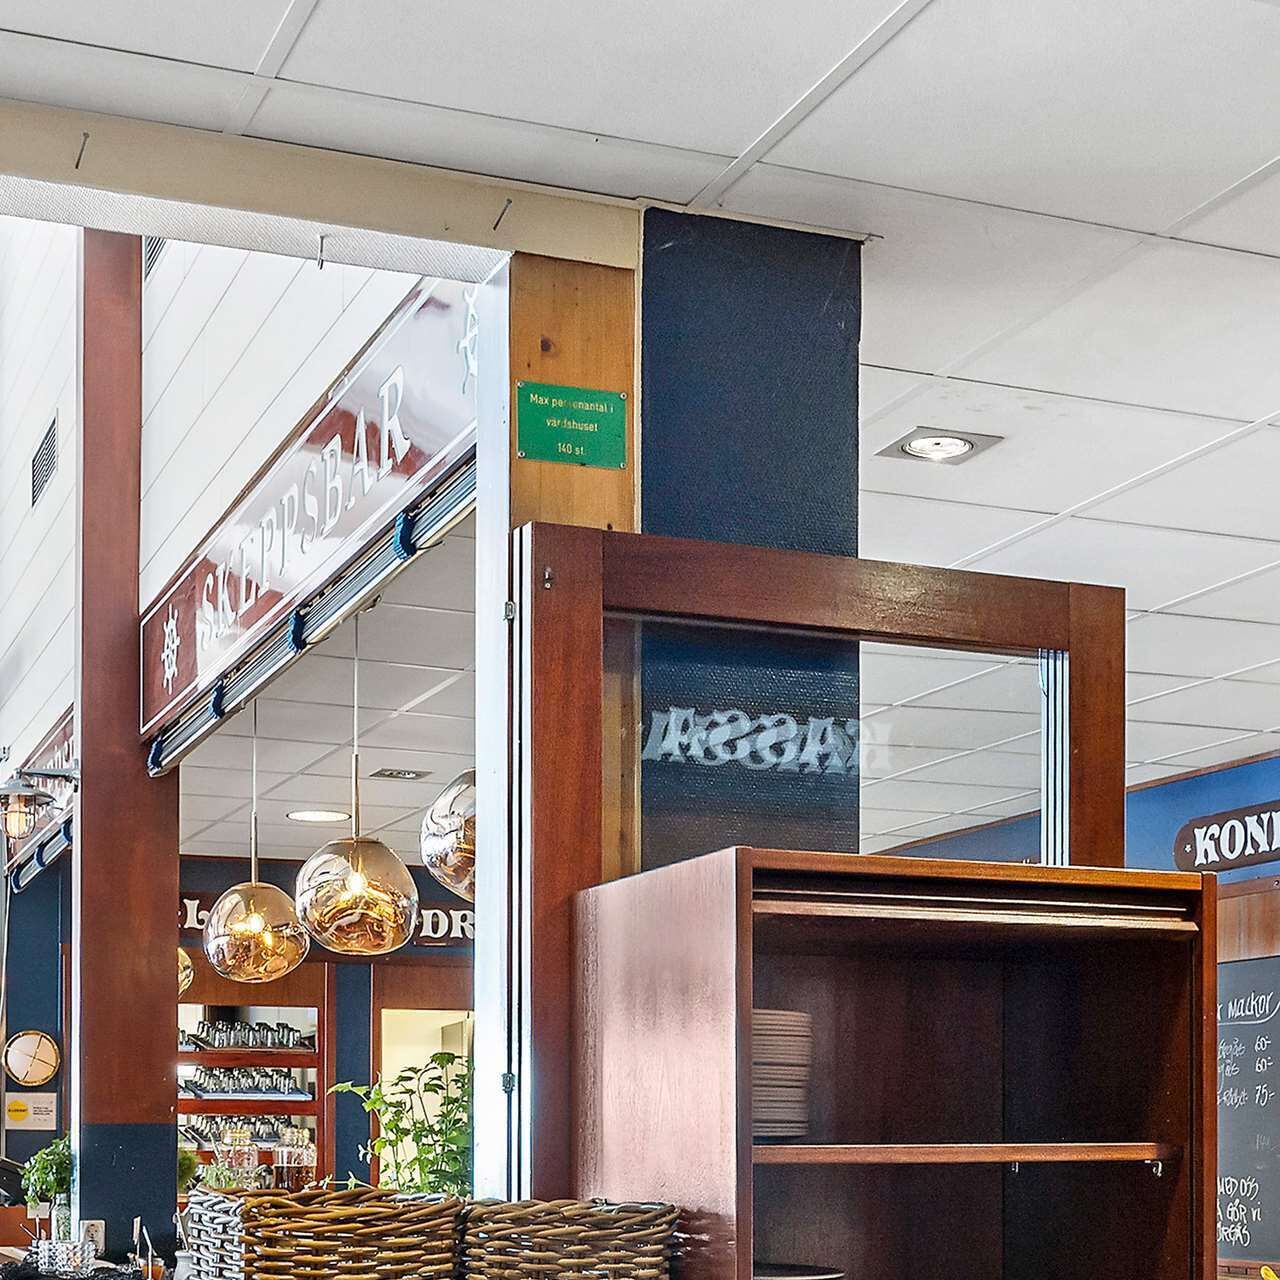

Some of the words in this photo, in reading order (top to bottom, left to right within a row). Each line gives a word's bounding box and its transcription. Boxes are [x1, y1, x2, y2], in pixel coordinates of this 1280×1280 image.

[529, 393, 548, 406] Max
[551, 397, 608, 413] peonantal
[557, 442, 573, 455] 140
[199, 365, 410, 651] SKEPPSBAR
